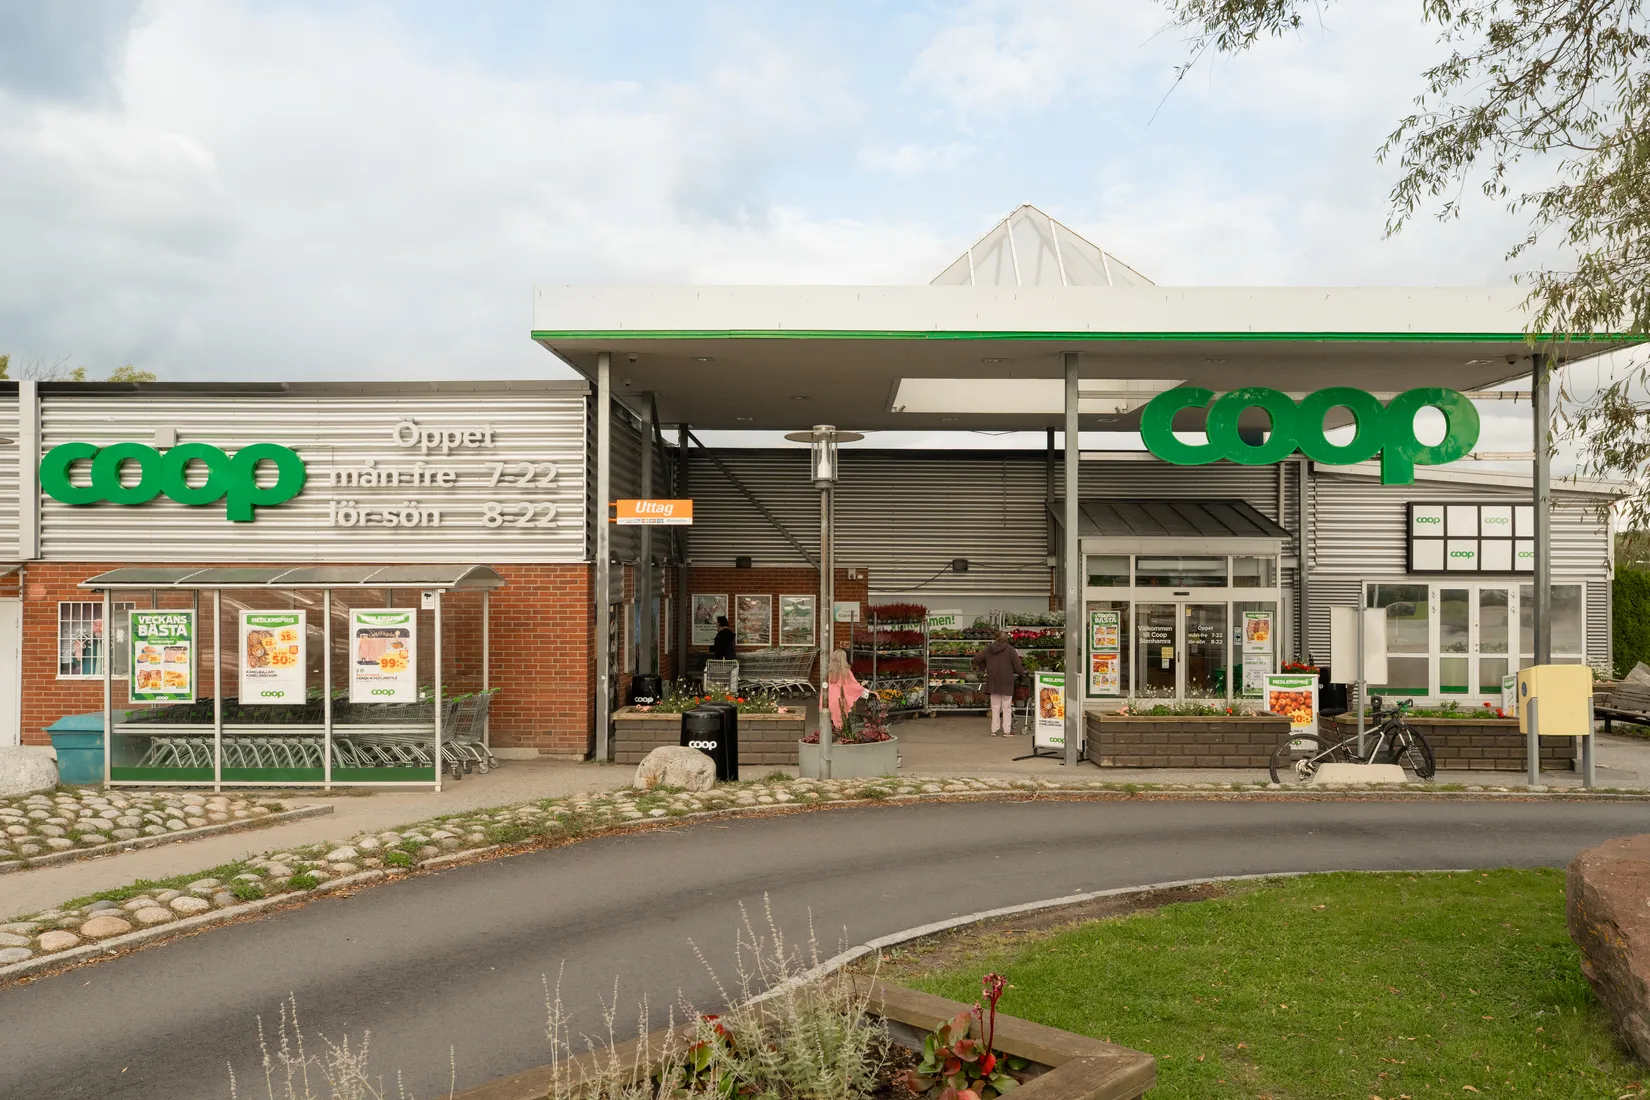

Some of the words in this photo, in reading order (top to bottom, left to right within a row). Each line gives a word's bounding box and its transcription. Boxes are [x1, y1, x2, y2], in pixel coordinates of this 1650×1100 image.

[393, 416, 496, 454] Öppet
[1140, 386, 1480, 485] coop
[330, 459, 457, 488] mån-fre
[484, 461, 558, 488] 7-22
[39, 442, 307, 521] coop
[329, 500, 440, 528] lör-sön
[482, 501, 557, 528] 8-22
[635, 501, 674, 517] Uttag
[1416, 516, 1441, 525] coop
[1484, 517, 1508, 525] coop
[1450, 550, 1475, 559] coop
[138, 615, 188, 624] VECKANS
[138, 623, 188, 637] BÄSTA
[280, 633, 297, 641] 35:-
[272, 656, 296, 665] 50:-
[381, 658, 404, 668] 99:-
[634, 697, 654, 705] coop
[688, 740, 718, 751] coop
